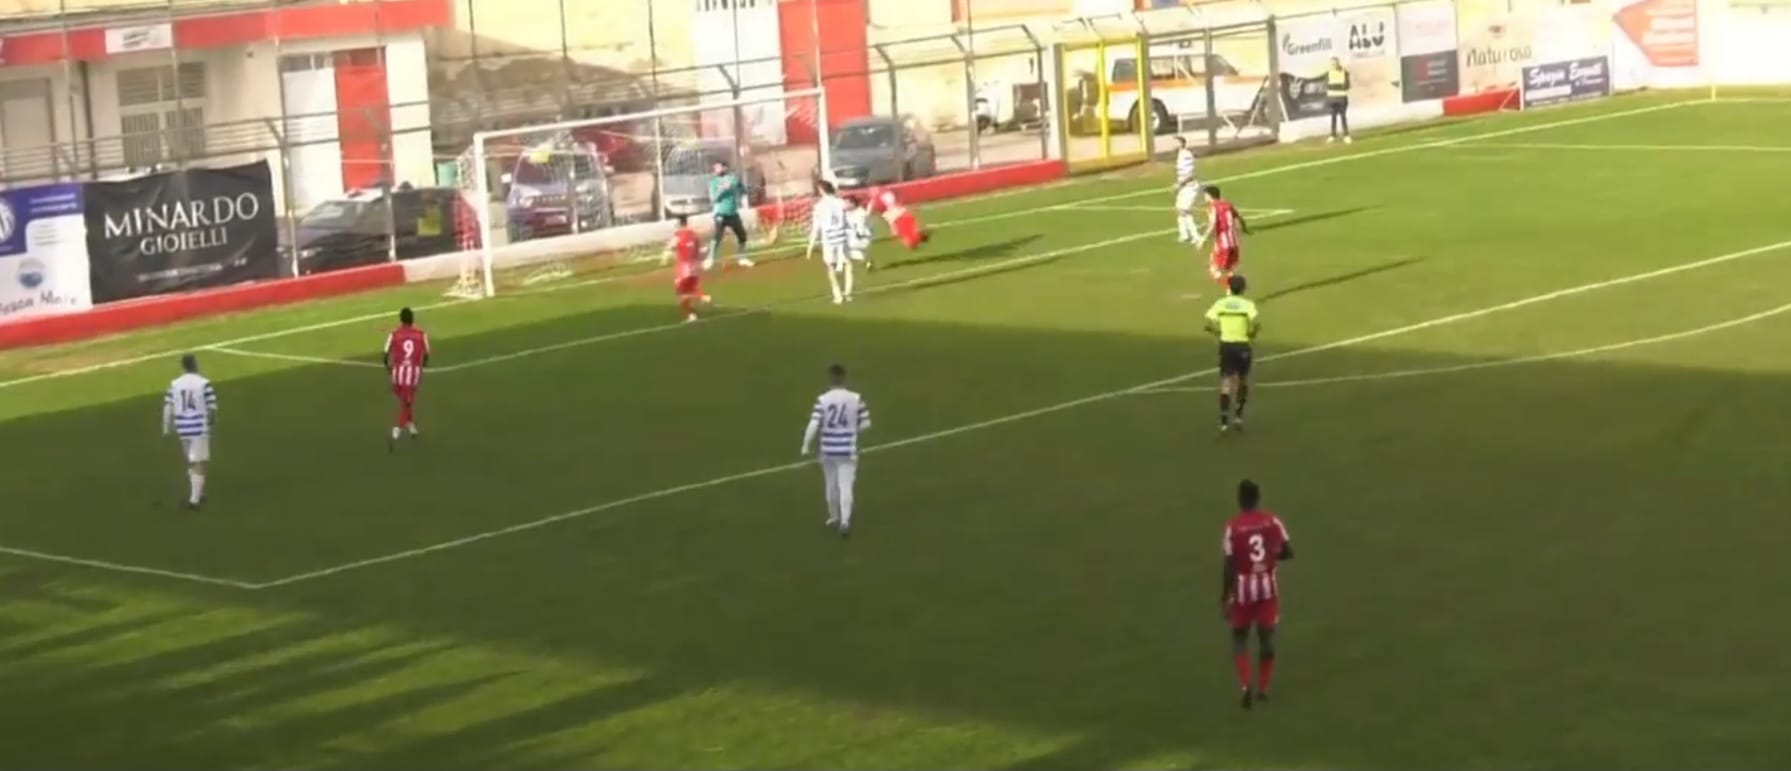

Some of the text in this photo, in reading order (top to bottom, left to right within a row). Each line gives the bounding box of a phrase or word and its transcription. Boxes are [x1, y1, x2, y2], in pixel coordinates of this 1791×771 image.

[104, 192, 259, 239] MINARDO
[140, 227, 228, 255] GIOIELLI
[403, 339, 414, 358] 9
[180, 389, 196, 412] 14
[827, 403, 848, 429] 24
[1248, 533, 1266, 562] 3
